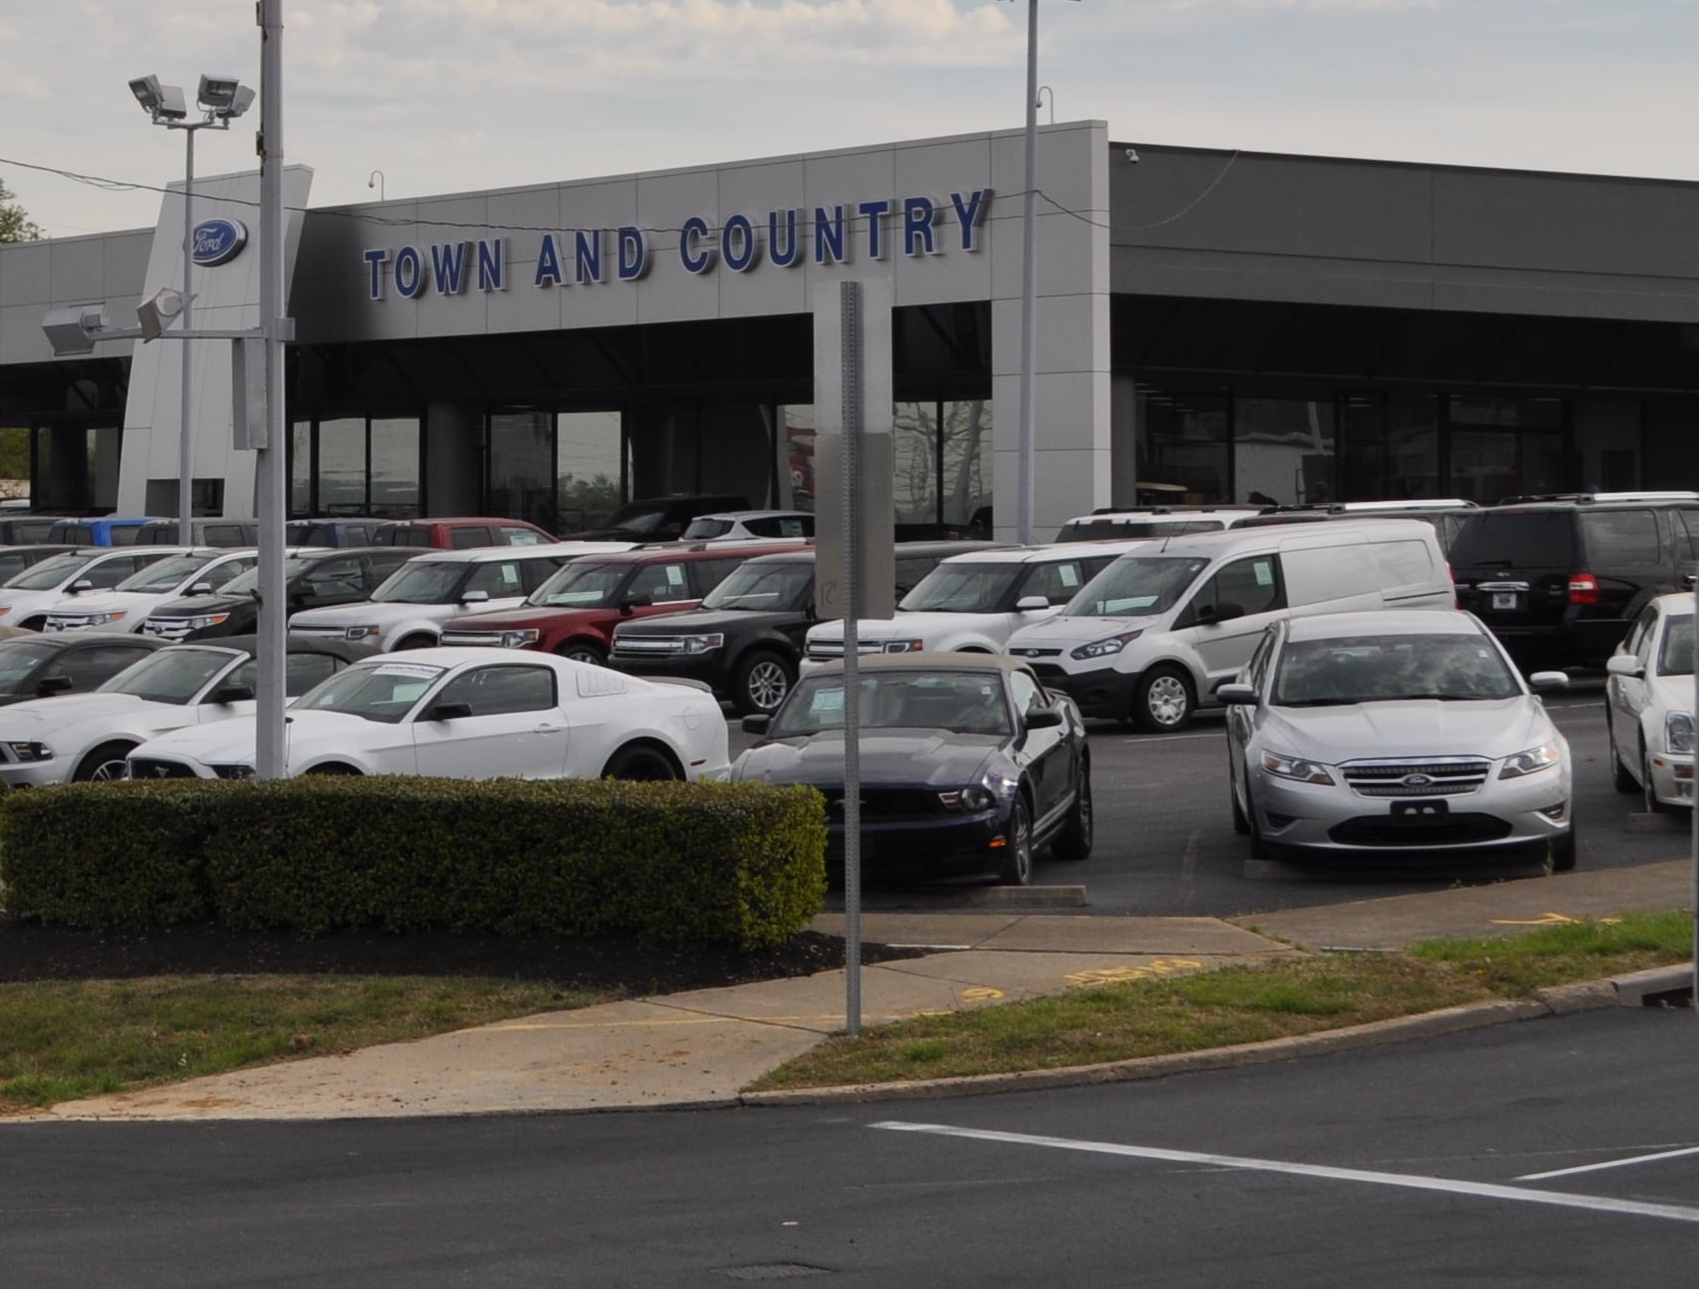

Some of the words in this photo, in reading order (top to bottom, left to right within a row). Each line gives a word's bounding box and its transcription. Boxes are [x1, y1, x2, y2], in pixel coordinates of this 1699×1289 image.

[193, 227, 225, 252] Ford
[363, 237, 507, 301] TOWN
[534, 225, 650, 289] AND
[680, 188, 993, 275] COUNTRY
